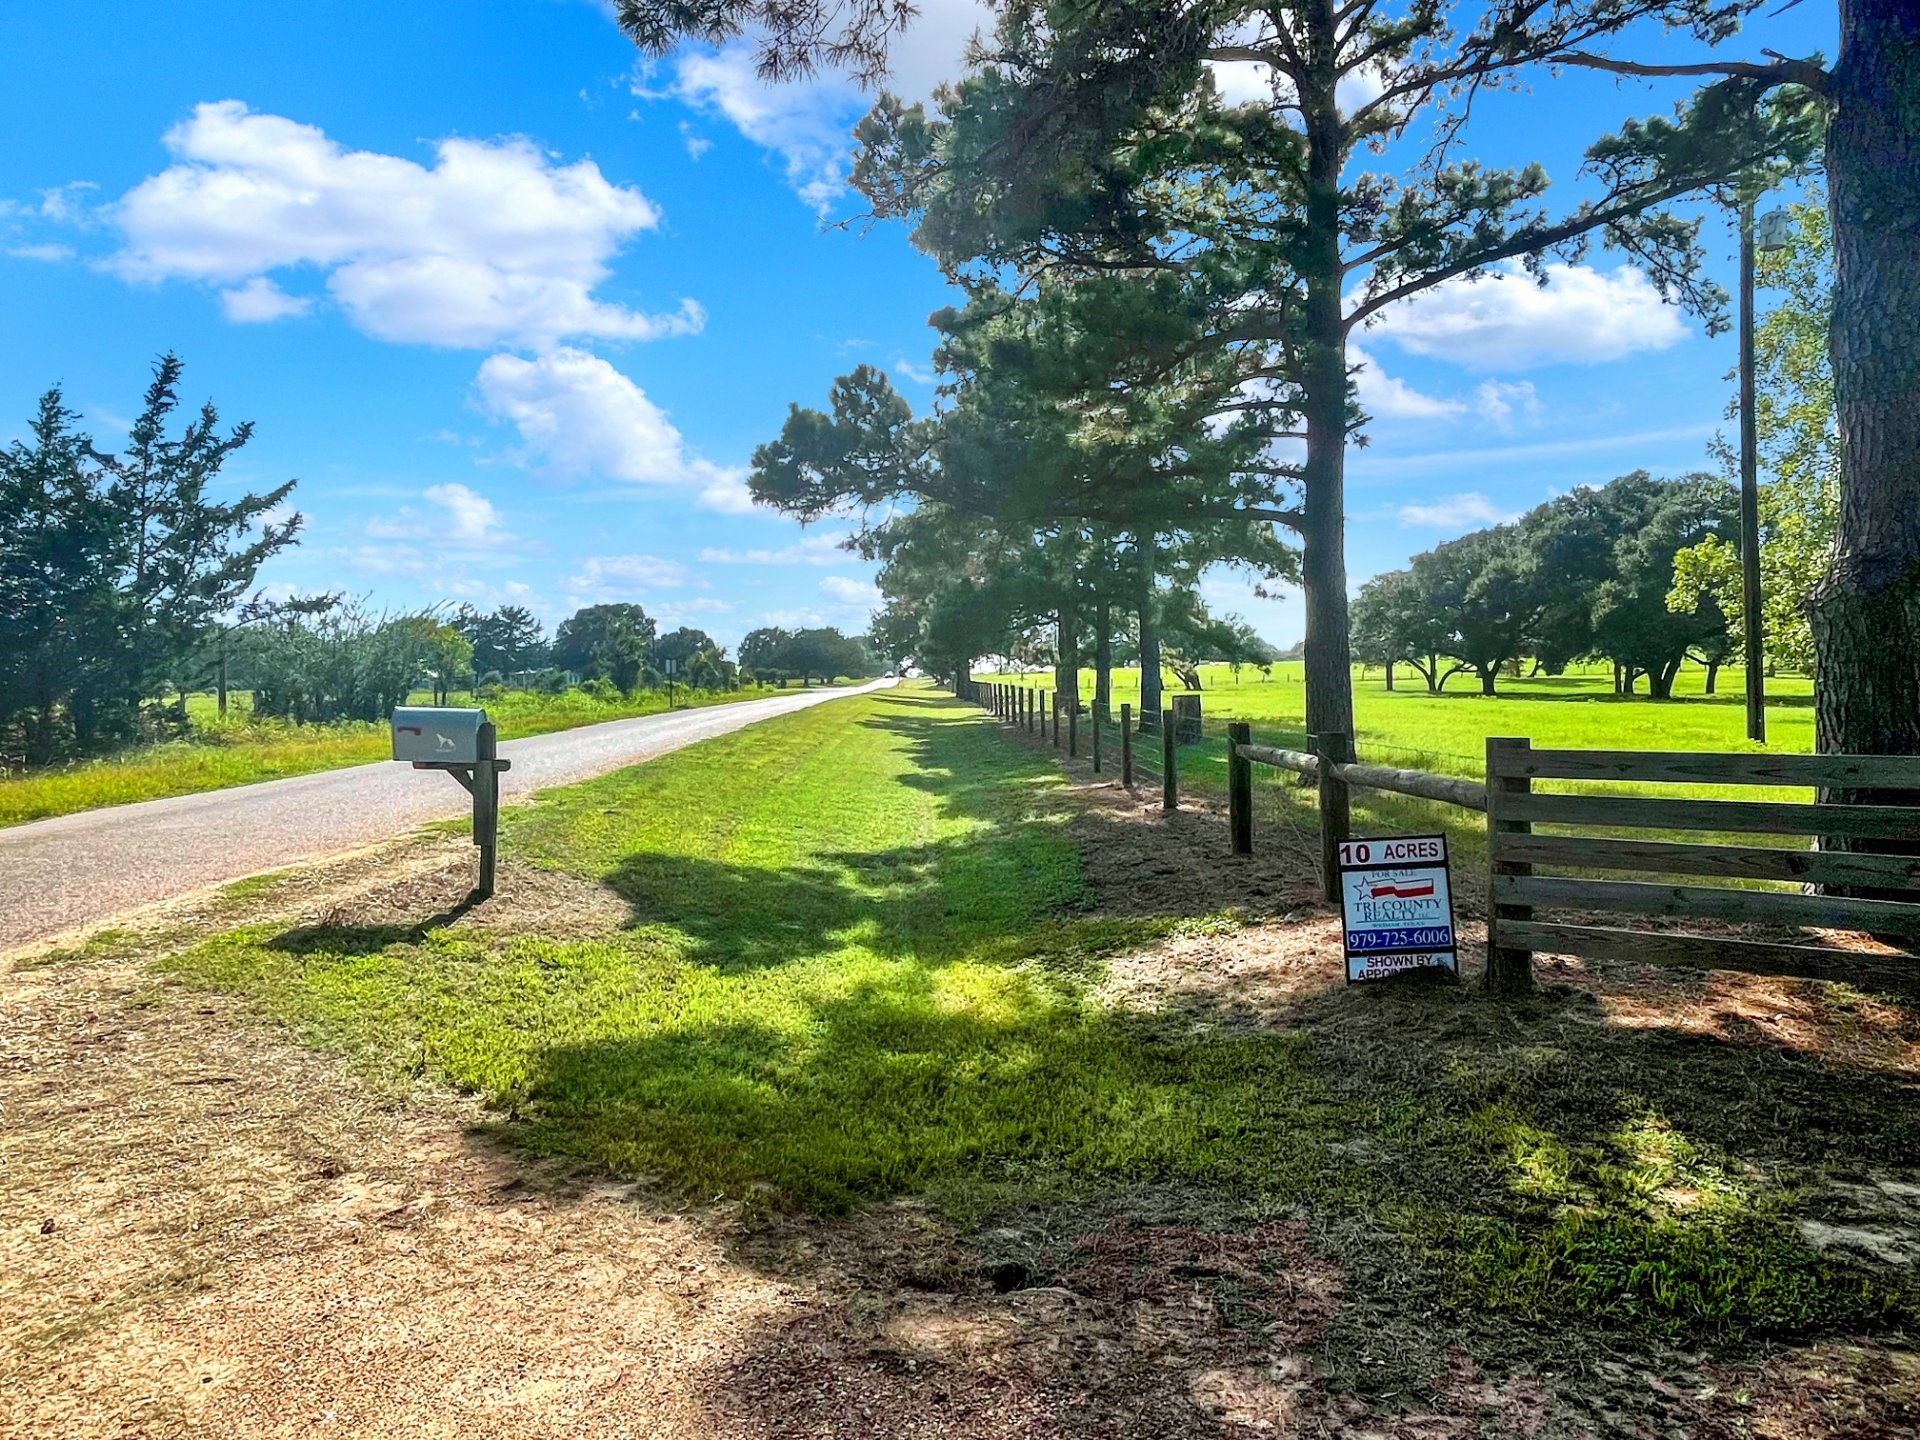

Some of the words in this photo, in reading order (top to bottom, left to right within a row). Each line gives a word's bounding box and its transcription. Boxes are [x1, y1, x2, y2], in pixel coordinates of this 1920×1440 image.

[1340, 844, 1370, 864] 10
[1384, 842, 1439, 859] ACRES
[1393, 869, 1416, 877] SALE
[1354, 899, 1442, 913] TRI-COUNTY
[1364, 911, 1416, 921] REALTY
[1350, 929, 1449, 948] 979-725-6006
[1367, 956, 1413, 968] SHOWN
[1416, 955, 1433, 966] BY
[1357, 967, 1406, 980] APPOIN
